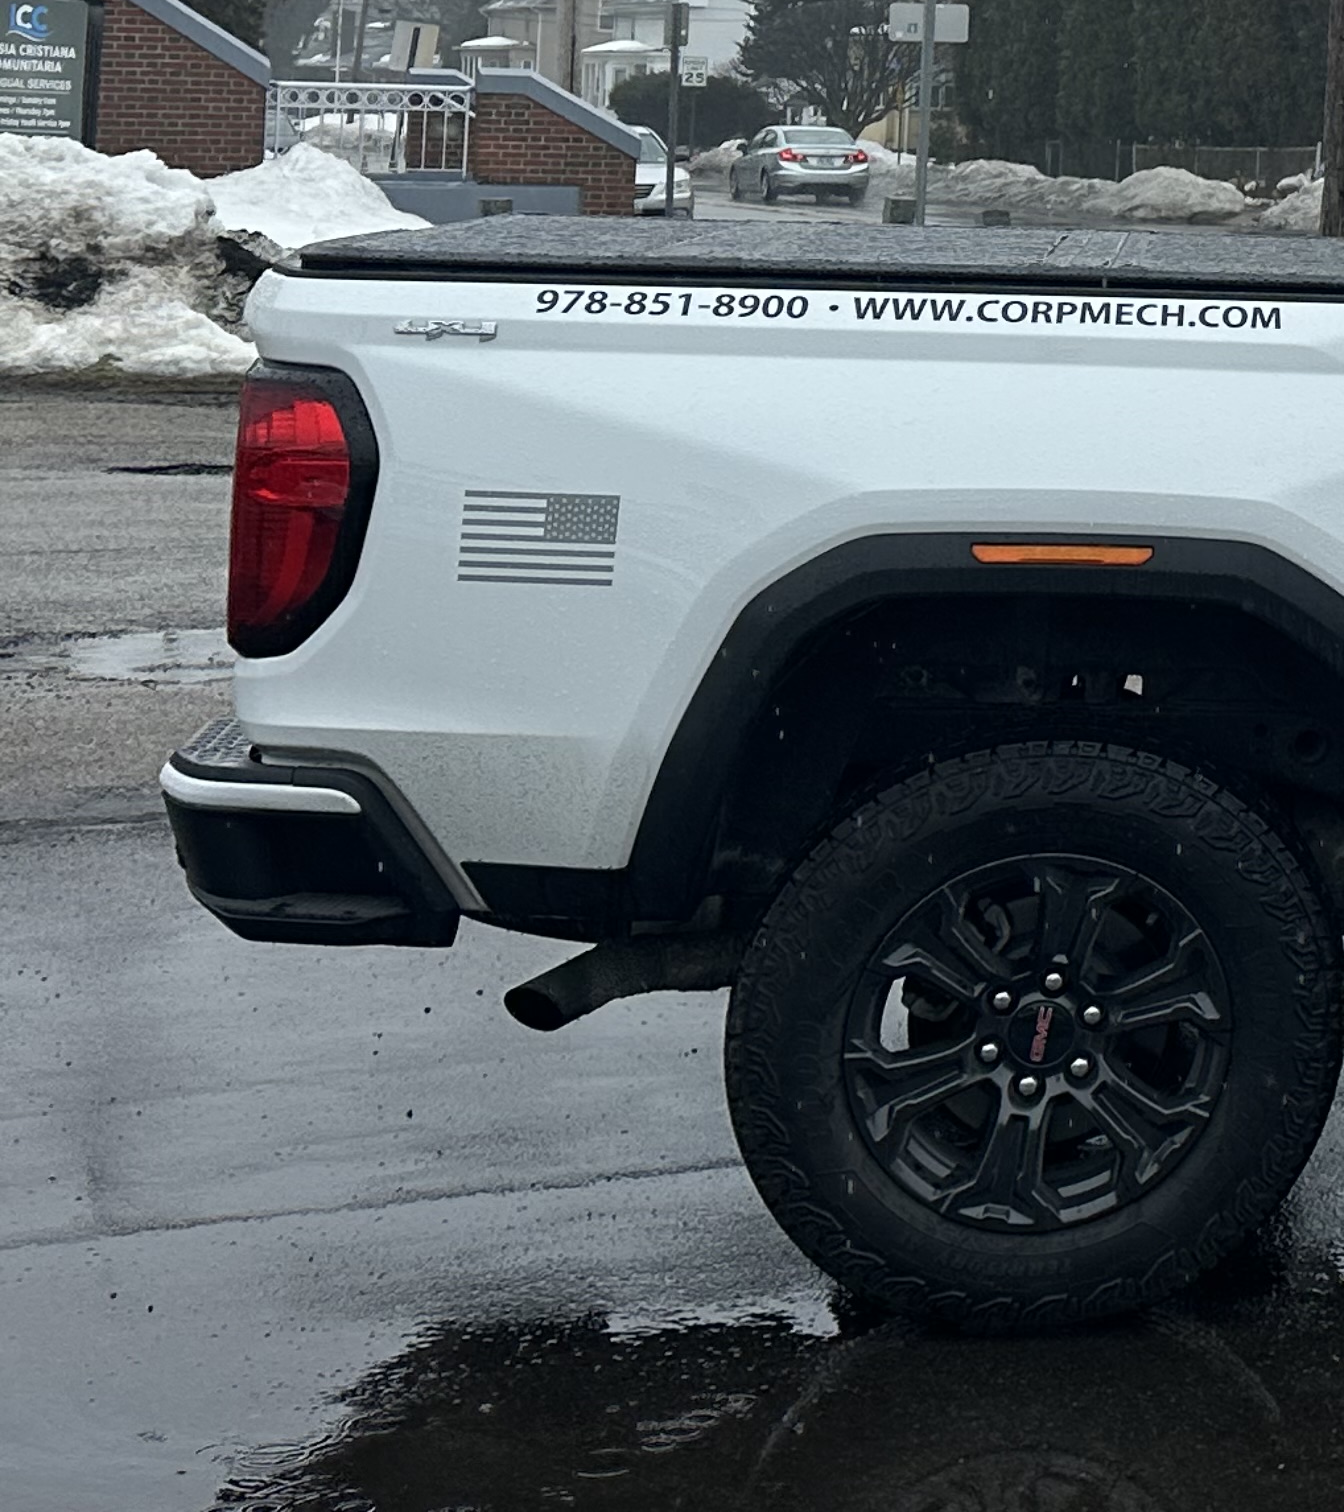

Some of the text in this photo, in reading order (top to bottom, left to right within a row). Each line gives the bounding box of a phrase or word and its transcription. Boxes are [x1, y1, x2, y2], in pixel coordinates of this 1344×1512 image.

[684, 72, 705, 84] 25
[535, 289, 1282, 330] 978-851-8900 WWW.CORPMECH.COM
[1029, 1005, 1053, 1062] GMC
